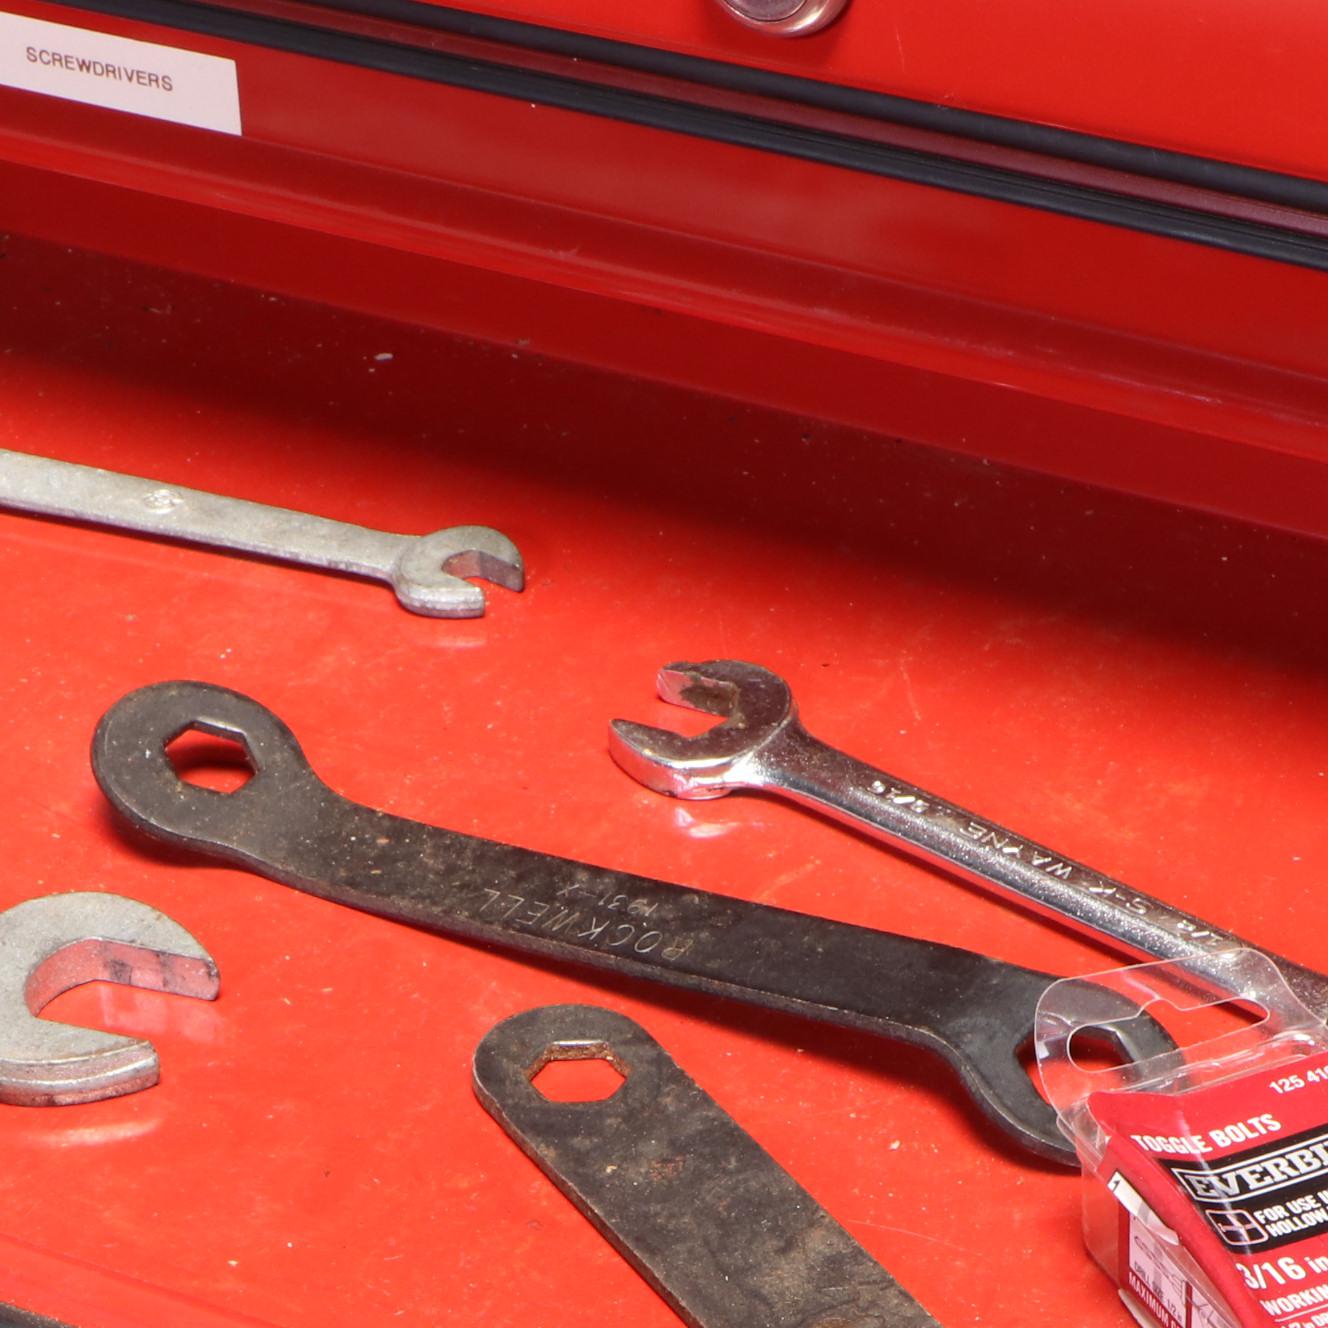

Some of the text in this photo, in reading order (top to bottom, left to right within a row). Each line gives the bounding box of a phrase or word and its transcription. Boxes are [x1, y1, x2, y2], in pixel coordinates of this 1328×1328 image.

[26, 46, 174, 92] SCREWDRIVERS
[959, 821, 1073, 879] WAYNE
[479, 888, 694, 961] ROCKWELL
[1269, 1074, 1304, 1094] 125
[1130, 1113, 1281, 1155] TOGGLE BOLTS
[1253, 1205, 1290, 1225] FOR
[1285, 1195, 1321, 1216] USE
[1236, 1256, 1306, 1290] 3/16
[1128, 1271, 1169, 1328] MAXIMUM
